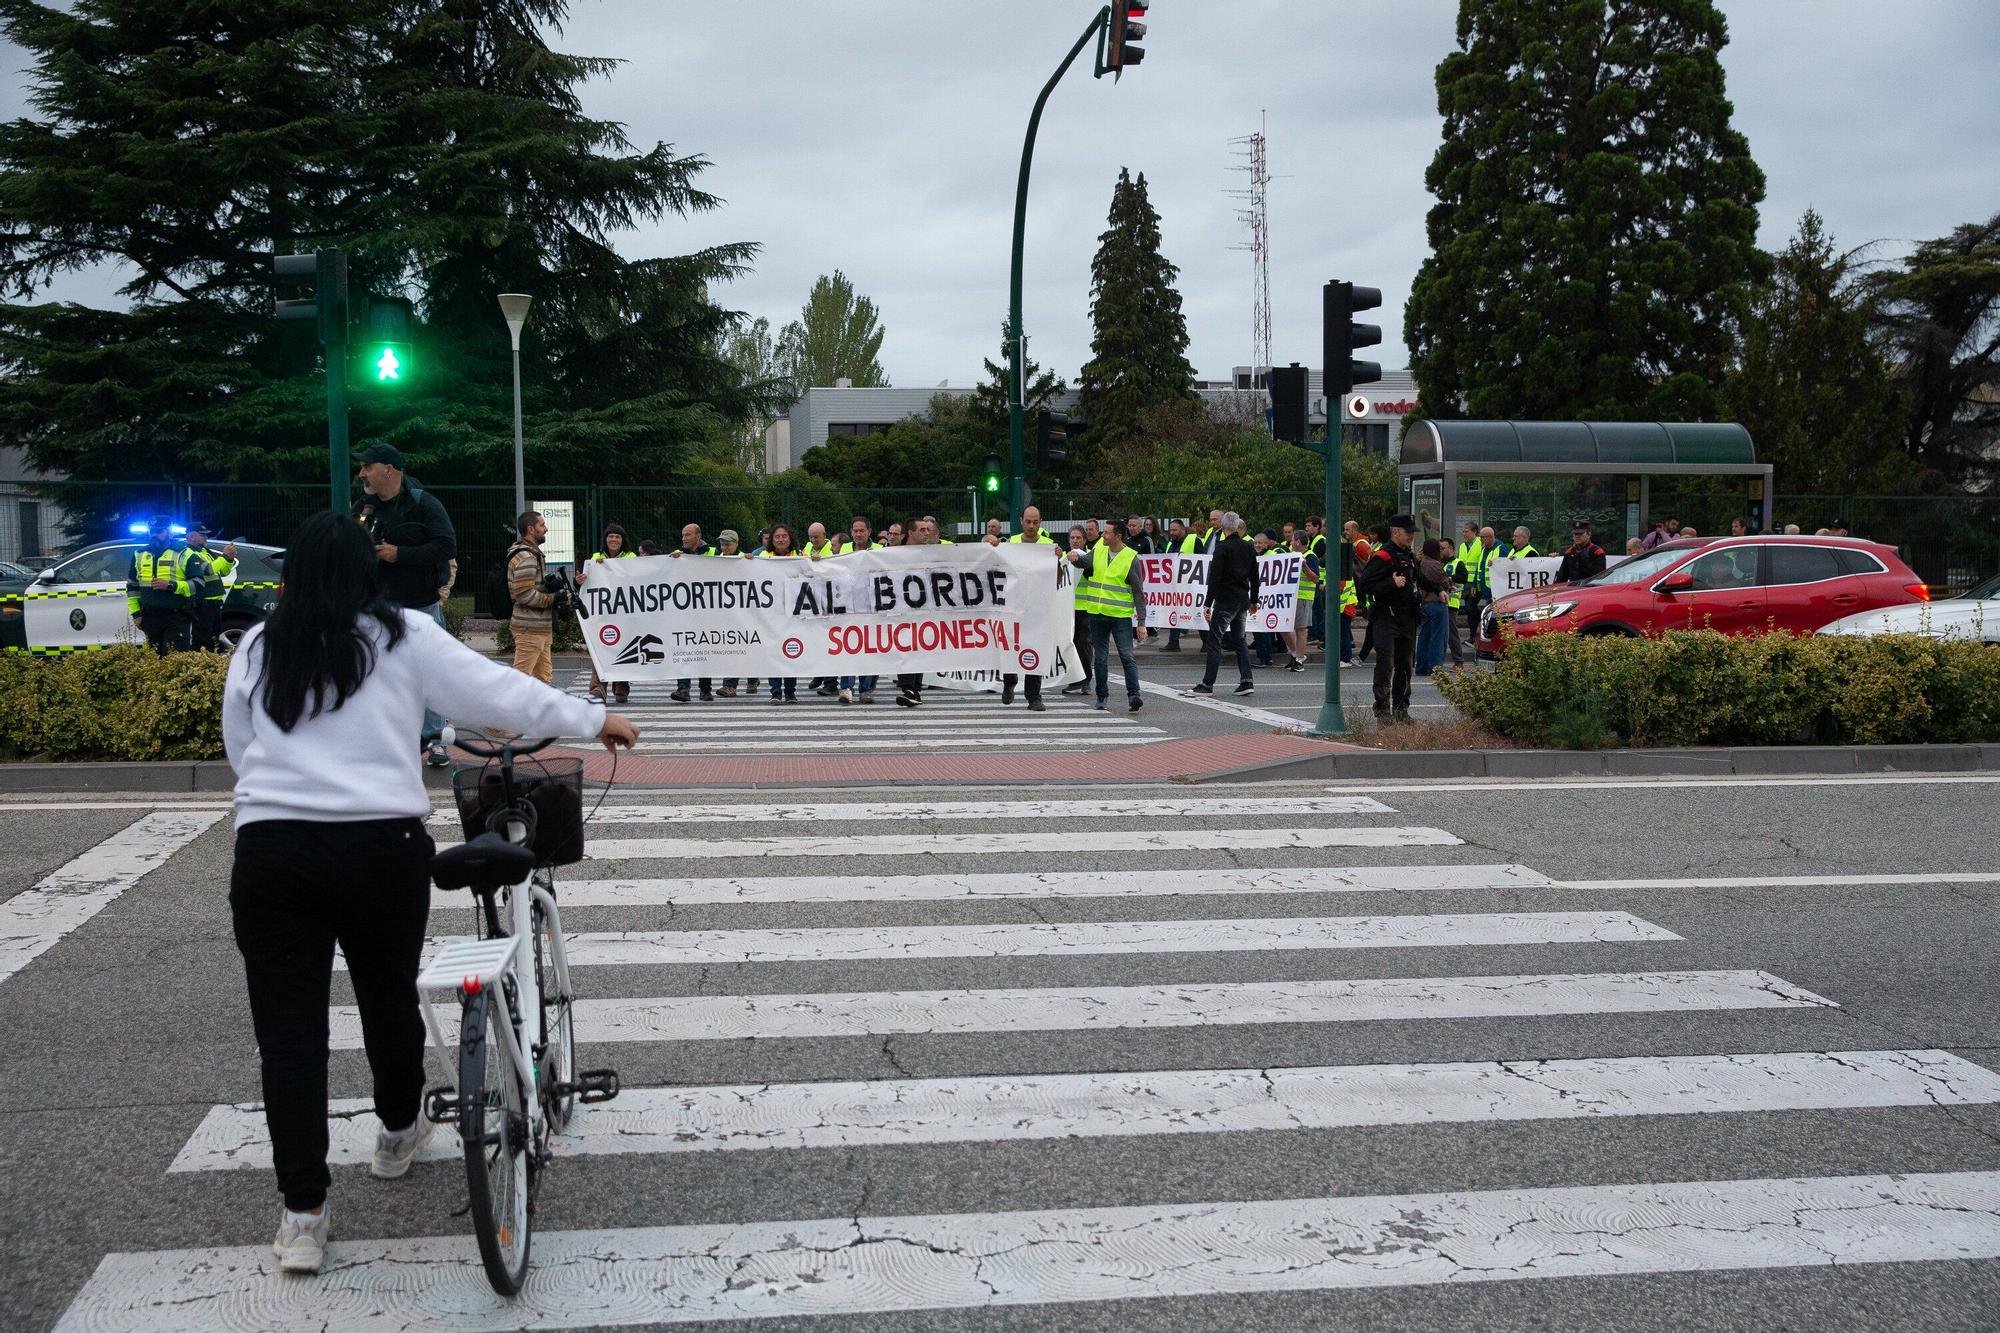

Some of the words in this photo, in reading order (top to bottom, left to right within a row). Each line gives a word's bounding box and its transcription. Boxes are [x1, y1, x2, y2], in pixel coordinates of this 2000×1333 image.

[1177, 559, 1212, 585] PA
[1258, 557, 1300, 587] ADIE
[1508, 571, 1524, 590] EL
[587, 580, 774, 615] TRANSPORTISTAS
[792, 580, 847, 616] AL
[874, 570, 1007, 612] BORDE
[828, 618, 988, 656] SOLUCIONES
